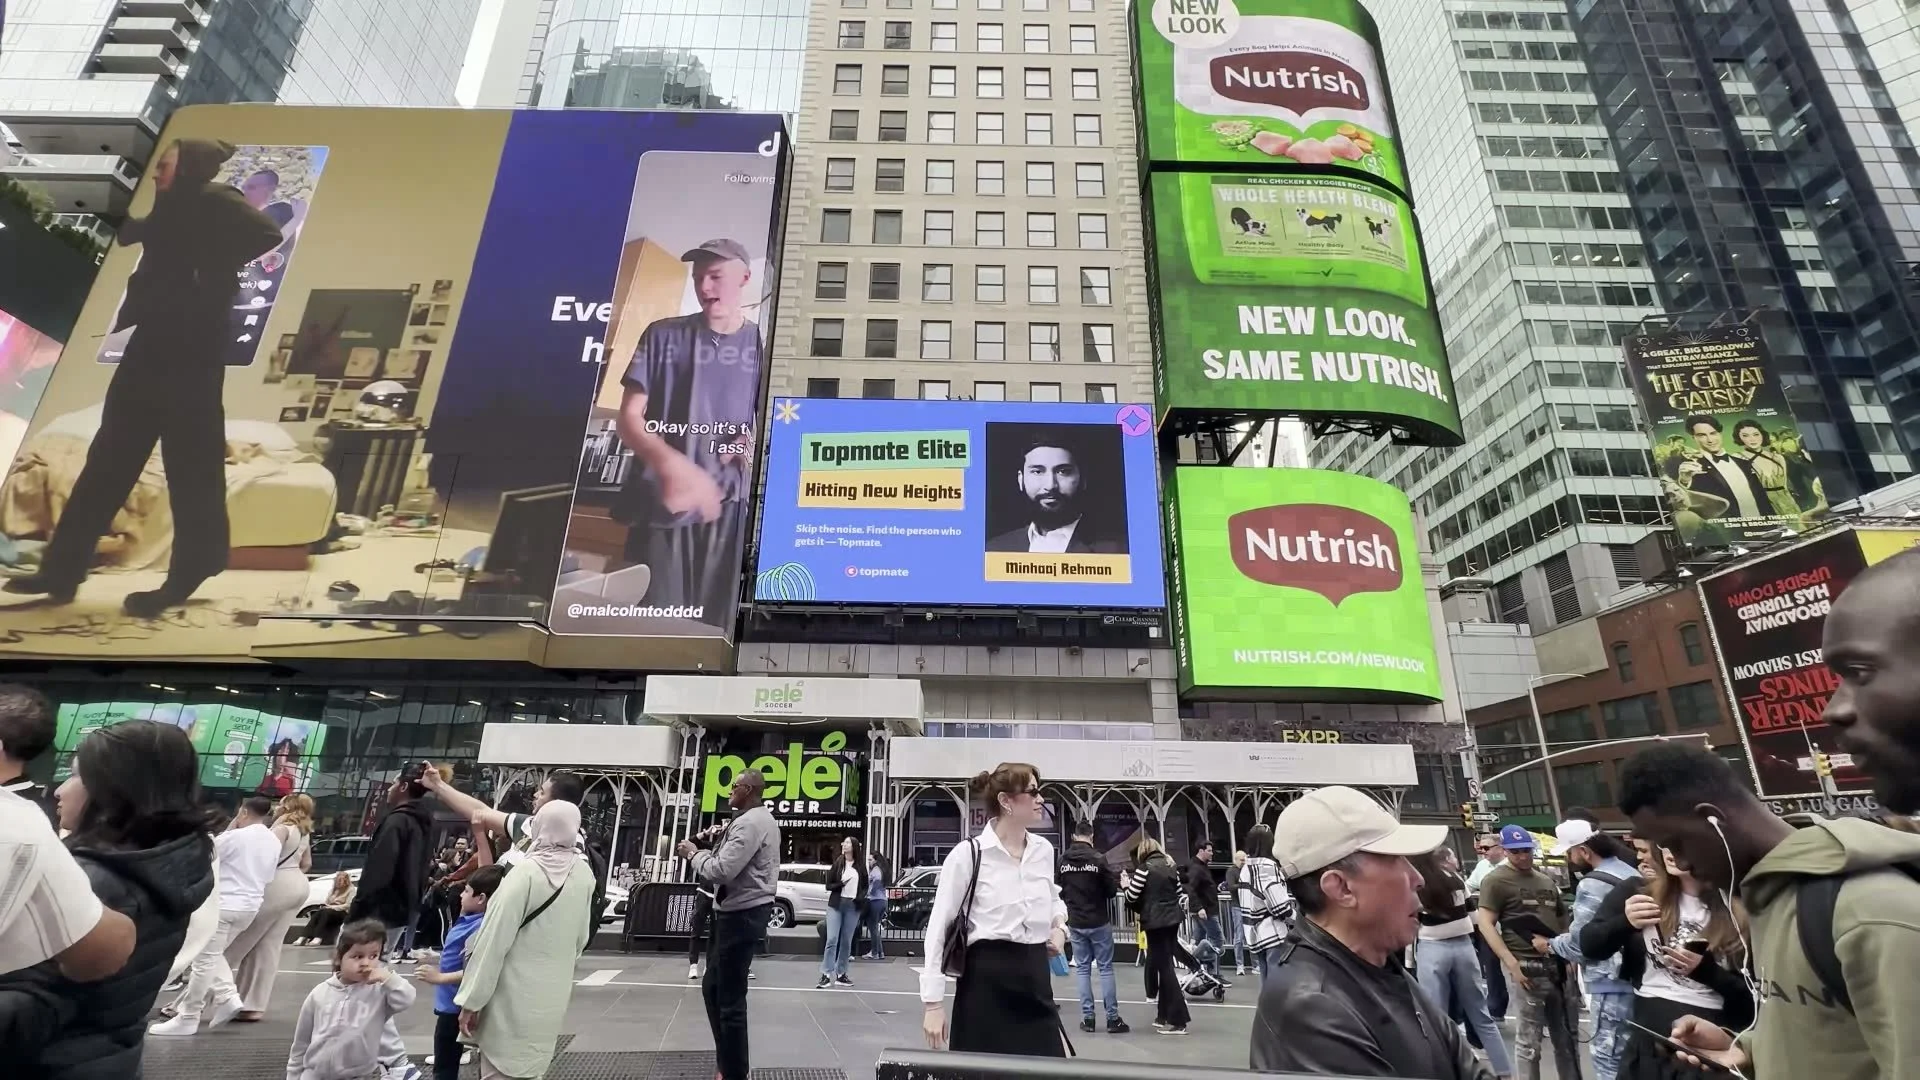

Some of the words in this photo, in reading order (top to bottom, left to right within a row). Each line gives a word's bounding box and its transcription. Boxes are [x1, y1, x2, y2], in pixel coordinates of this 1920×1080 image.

[1170, 0, 1219, 16] NEW
[1168, 18, 1227, 34] LOOK
[1224, 65, 1362, 100] Nutrish
[724, 174, 776, 184] Following
[1314, 179, 1346, 187] VEGGIES
[1347, 182, 1372, 192] RECIPE
[1218, 187, 1278, 203] WHOLE
[1286, 188, 1348, 205] HEALTH
[1352, 193, 1396, 217] BLEND
[1238, 305, 1316, 335] NEW
[1325, 306, 1417, 348] LOOK.
[581, 336, 606, 363] h
[1664, 351, 1740, 363] EXTRAVAGANZA
[1684, 346, 1702, 354] BIG
[1702, 342, 1756, 352] BROADWAY
[1202, 349, 1304, 381] SAME
[1310, 351, 1448, 404] NUTRISH.
[1647, 372, 1690, 393] THE
[1692, 366, 1765, 390] GREAT
[1668, 386, 1756, 410] GATSBY
[1714, 406, 1749, 414] MUSICAL
[645, 420, 688, 436] Okay
[690, 423, 710, 434] so
[709, 441, 716, 454] I
[810, 440, 910, 466] Topmate
[917, 439, 967, 460] Elite
[805, 482, 858, 502] Hitting
[862, 483, 898, 498] New
[903, 483, 962, 502] Heights
[794, 537, 815, 549] gets
[815, 536, 825, 548] it
[838, 537, 882, 549] Topmate.
[795, 523, 818, 536] Skip
[818, 524, 834, 535] the
[836, 524, 864, 536] noise.
[866, 525, 888, 536] Find
[888, 525, 905, 536] the
[906, 526, 940, 538] person
[940, 526, 962, 536] who
[1245, 527, 1398, 573] Nutrish
[858, 566, 910, 578] topmate
[1005, 562, 1057, 577] Minhaaj
[1060, 562, 1112, 576] Rehman
[1776, 566, 1832, 593] UPSIDE
[1728, 584, 1774, 608] DOWN
[1794, 582, 1830, 605] HAS
[567, 604, 704, 618] @malcolmtodddd
[1176, 594, 1184, 636] LOOK.
[1737, 594, 1794, 620] TURNED
[1745, 599, 1832, 635] BROADWAY
[1234, 650, 1426, 674] NUTRISH.COM/NEWLOOK
[1733, 655, 1793, 680] SHADOW
[754, 680, 804, 708] pelé
[701, 730, 847, 812] pelé
[808, 820, 836, 828] SOCCER
[838, 820, 862, 828] STORE
[318, 1000, 370, 1035] GAP
